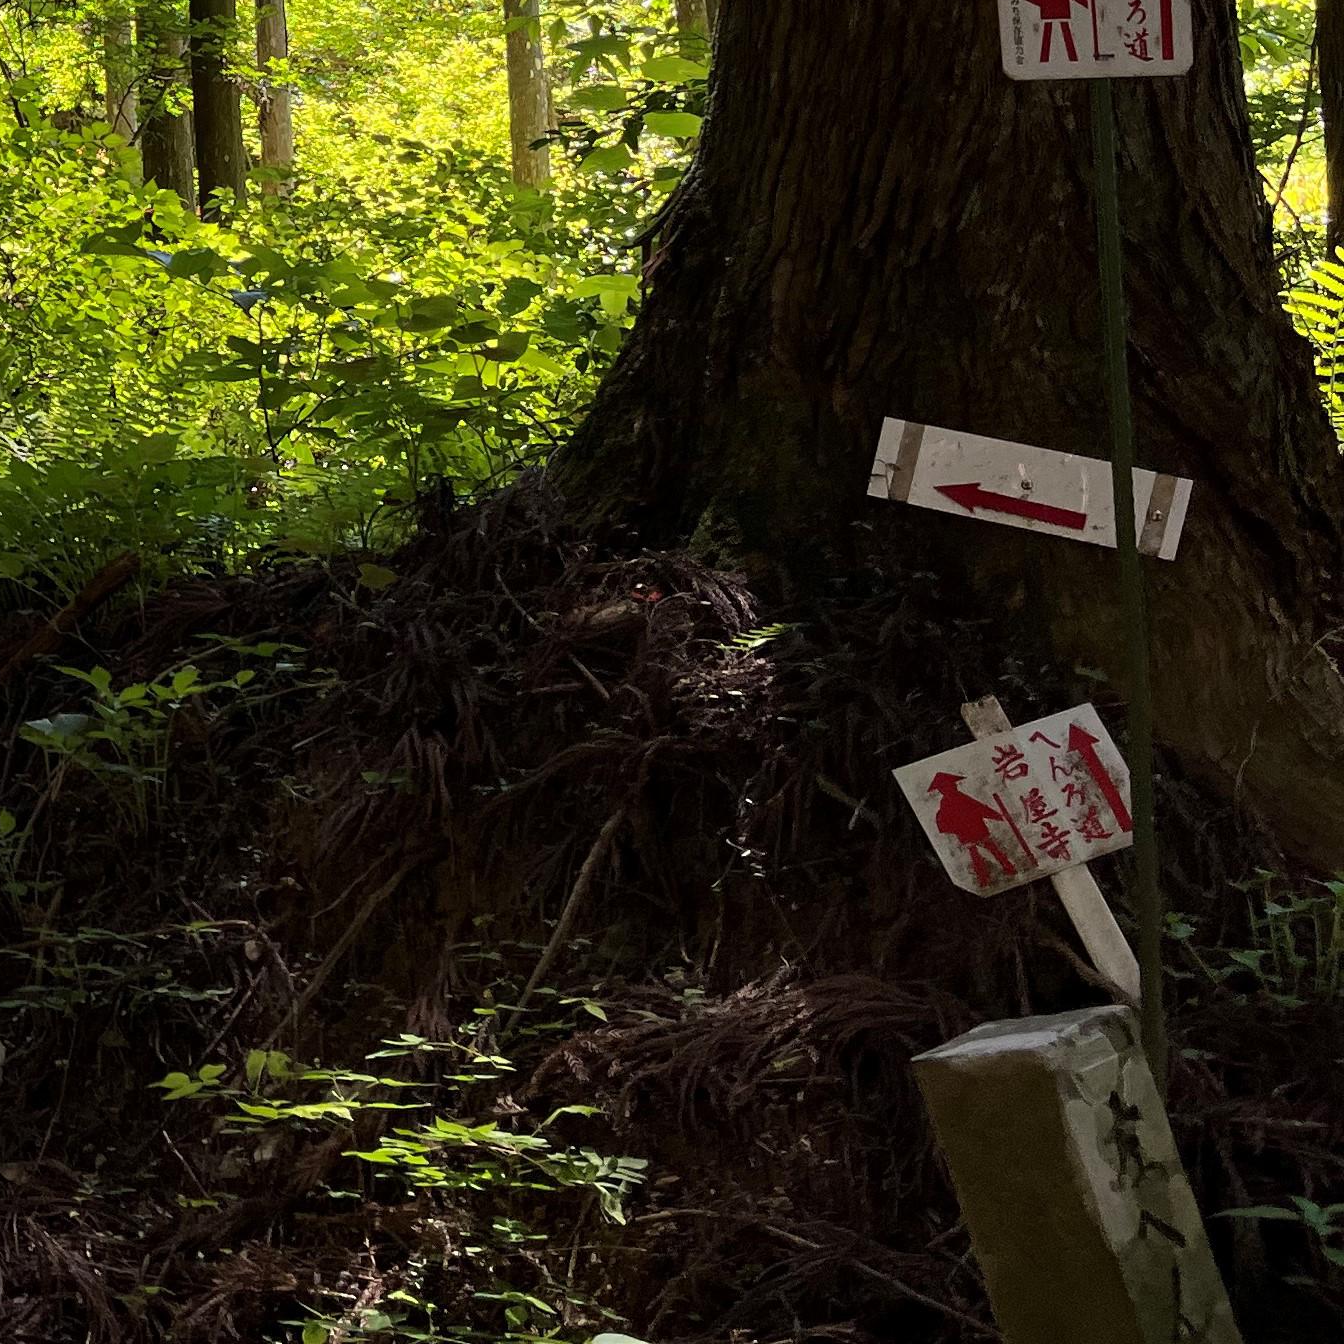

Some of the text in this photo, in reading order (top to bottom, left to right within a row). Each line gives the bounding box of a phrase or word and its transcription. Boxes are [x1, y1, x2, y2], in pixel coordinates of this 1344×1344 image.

[991, 743, 1071, 862] 岩屋寺
[1029, 731, 1114, 843] へんろ道
